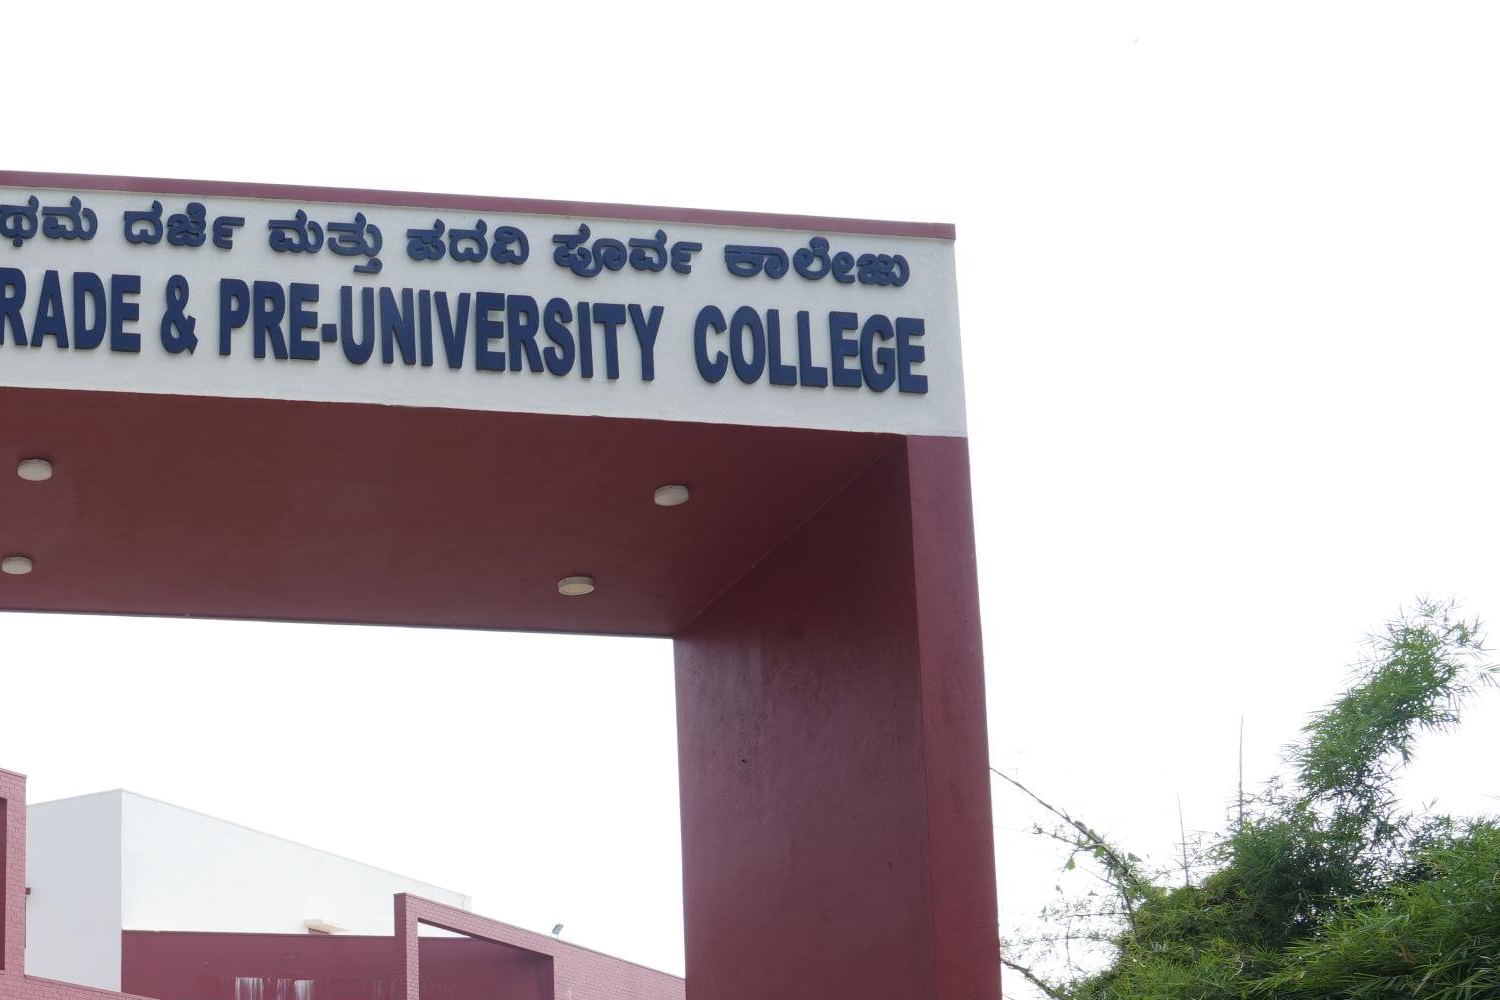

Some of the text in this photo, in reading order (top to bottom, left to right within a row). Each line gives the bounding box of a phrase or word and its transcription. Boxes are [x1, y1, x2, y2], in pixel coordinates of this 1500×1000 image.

[124, 200, 246, 251] ದರ್ಜೆ
[268, 209, 383, 276] ಮತ್ತು
[407, 219, 530, 267] ಪದವಿ
[552, 223, 703, 279] ಪೂರ್ವ
[724, 237, 911, 289] ಕಾಲೇಜು
[160, 275, 198, 354] &
[219, 278, 665, 383] PRE-UNIVERSITY
[694, 306, 929, 396] COLLEGE
